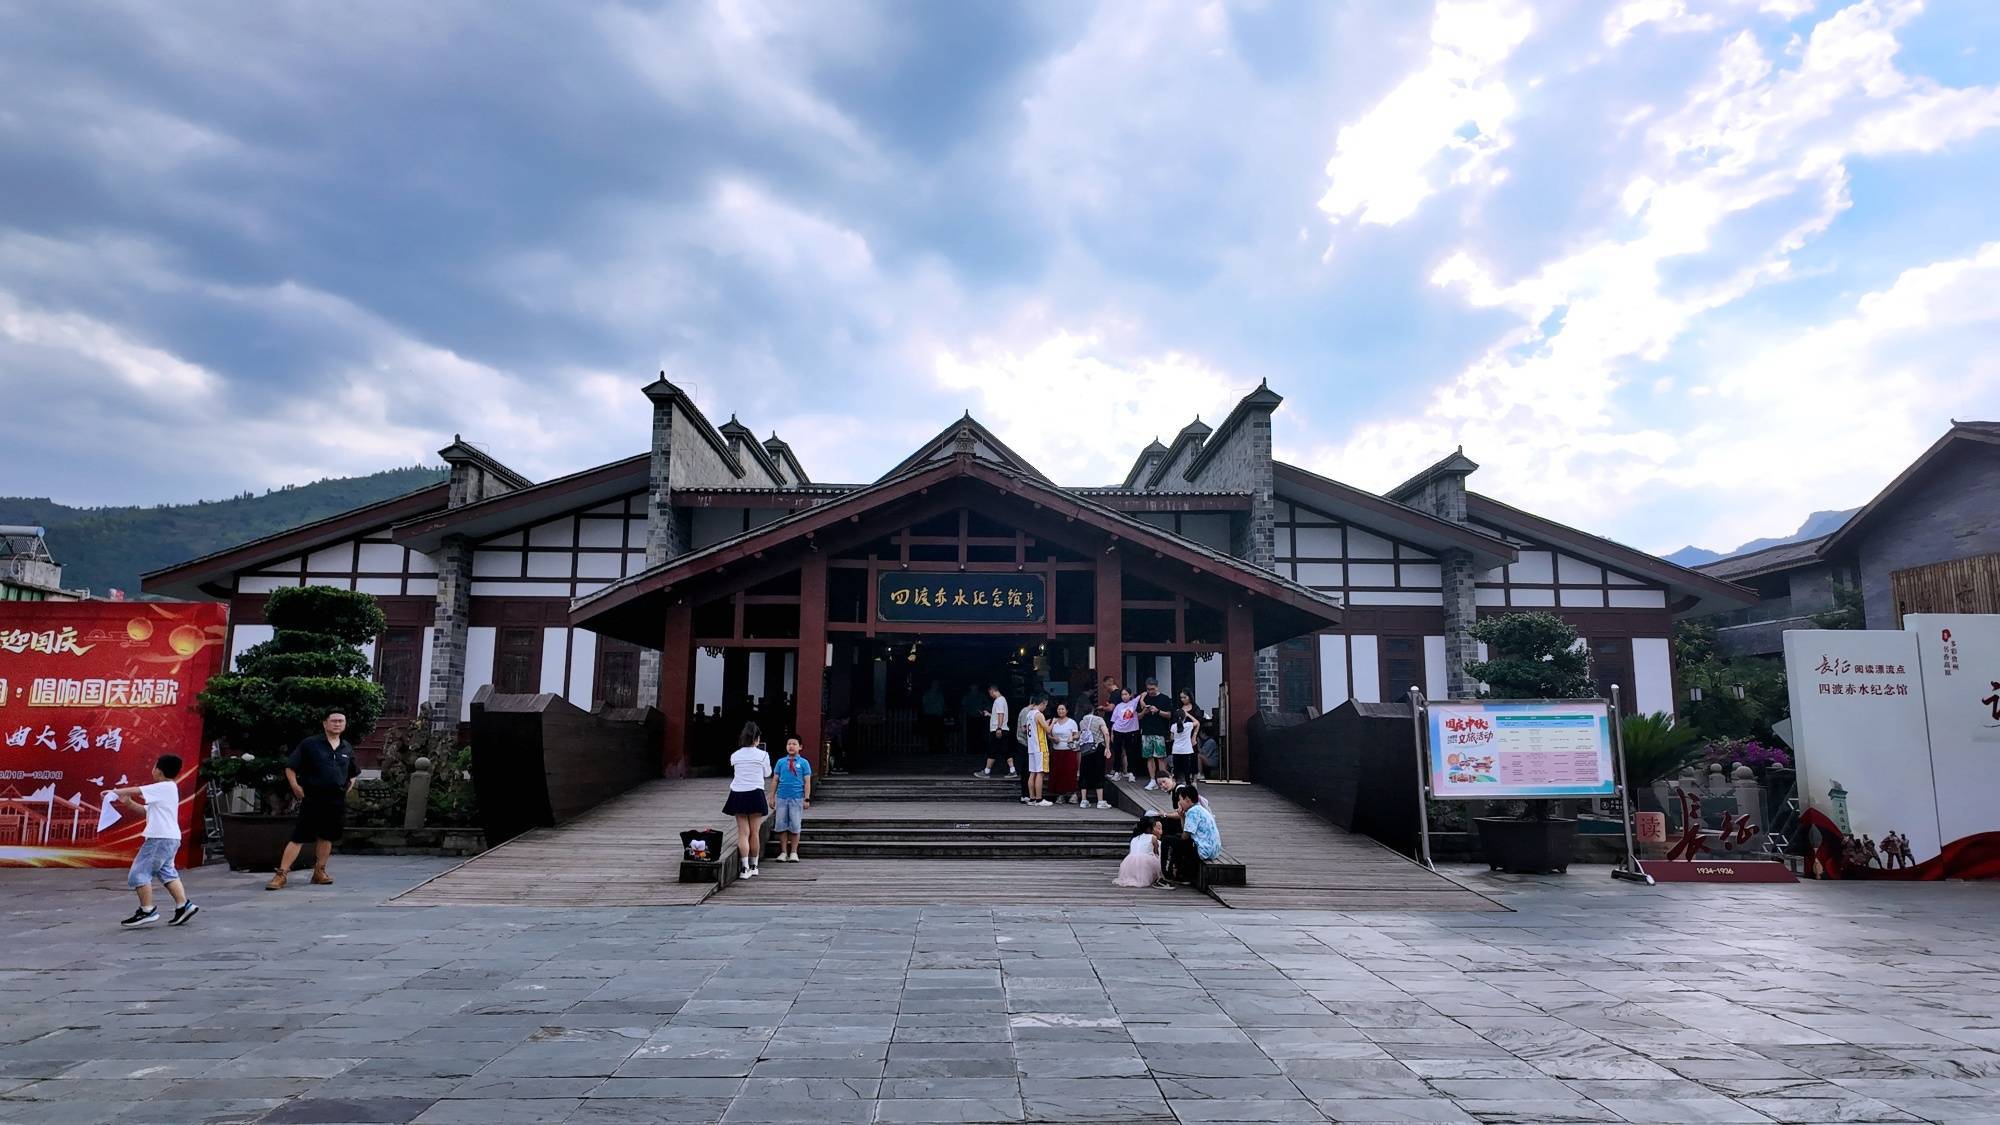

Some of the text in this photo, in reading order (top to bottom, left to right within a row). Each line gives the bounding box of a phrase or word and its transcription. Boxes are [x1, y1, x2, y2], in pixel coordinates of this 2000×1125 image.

[0, 626, 97, 656] 迎国庆
[1819, 683, 1908, 696] 四渡赤水纪念馆
[5, 724, 123, 752] 曲大家唱
[1696, 867, 1734, 875] 1934-1936
